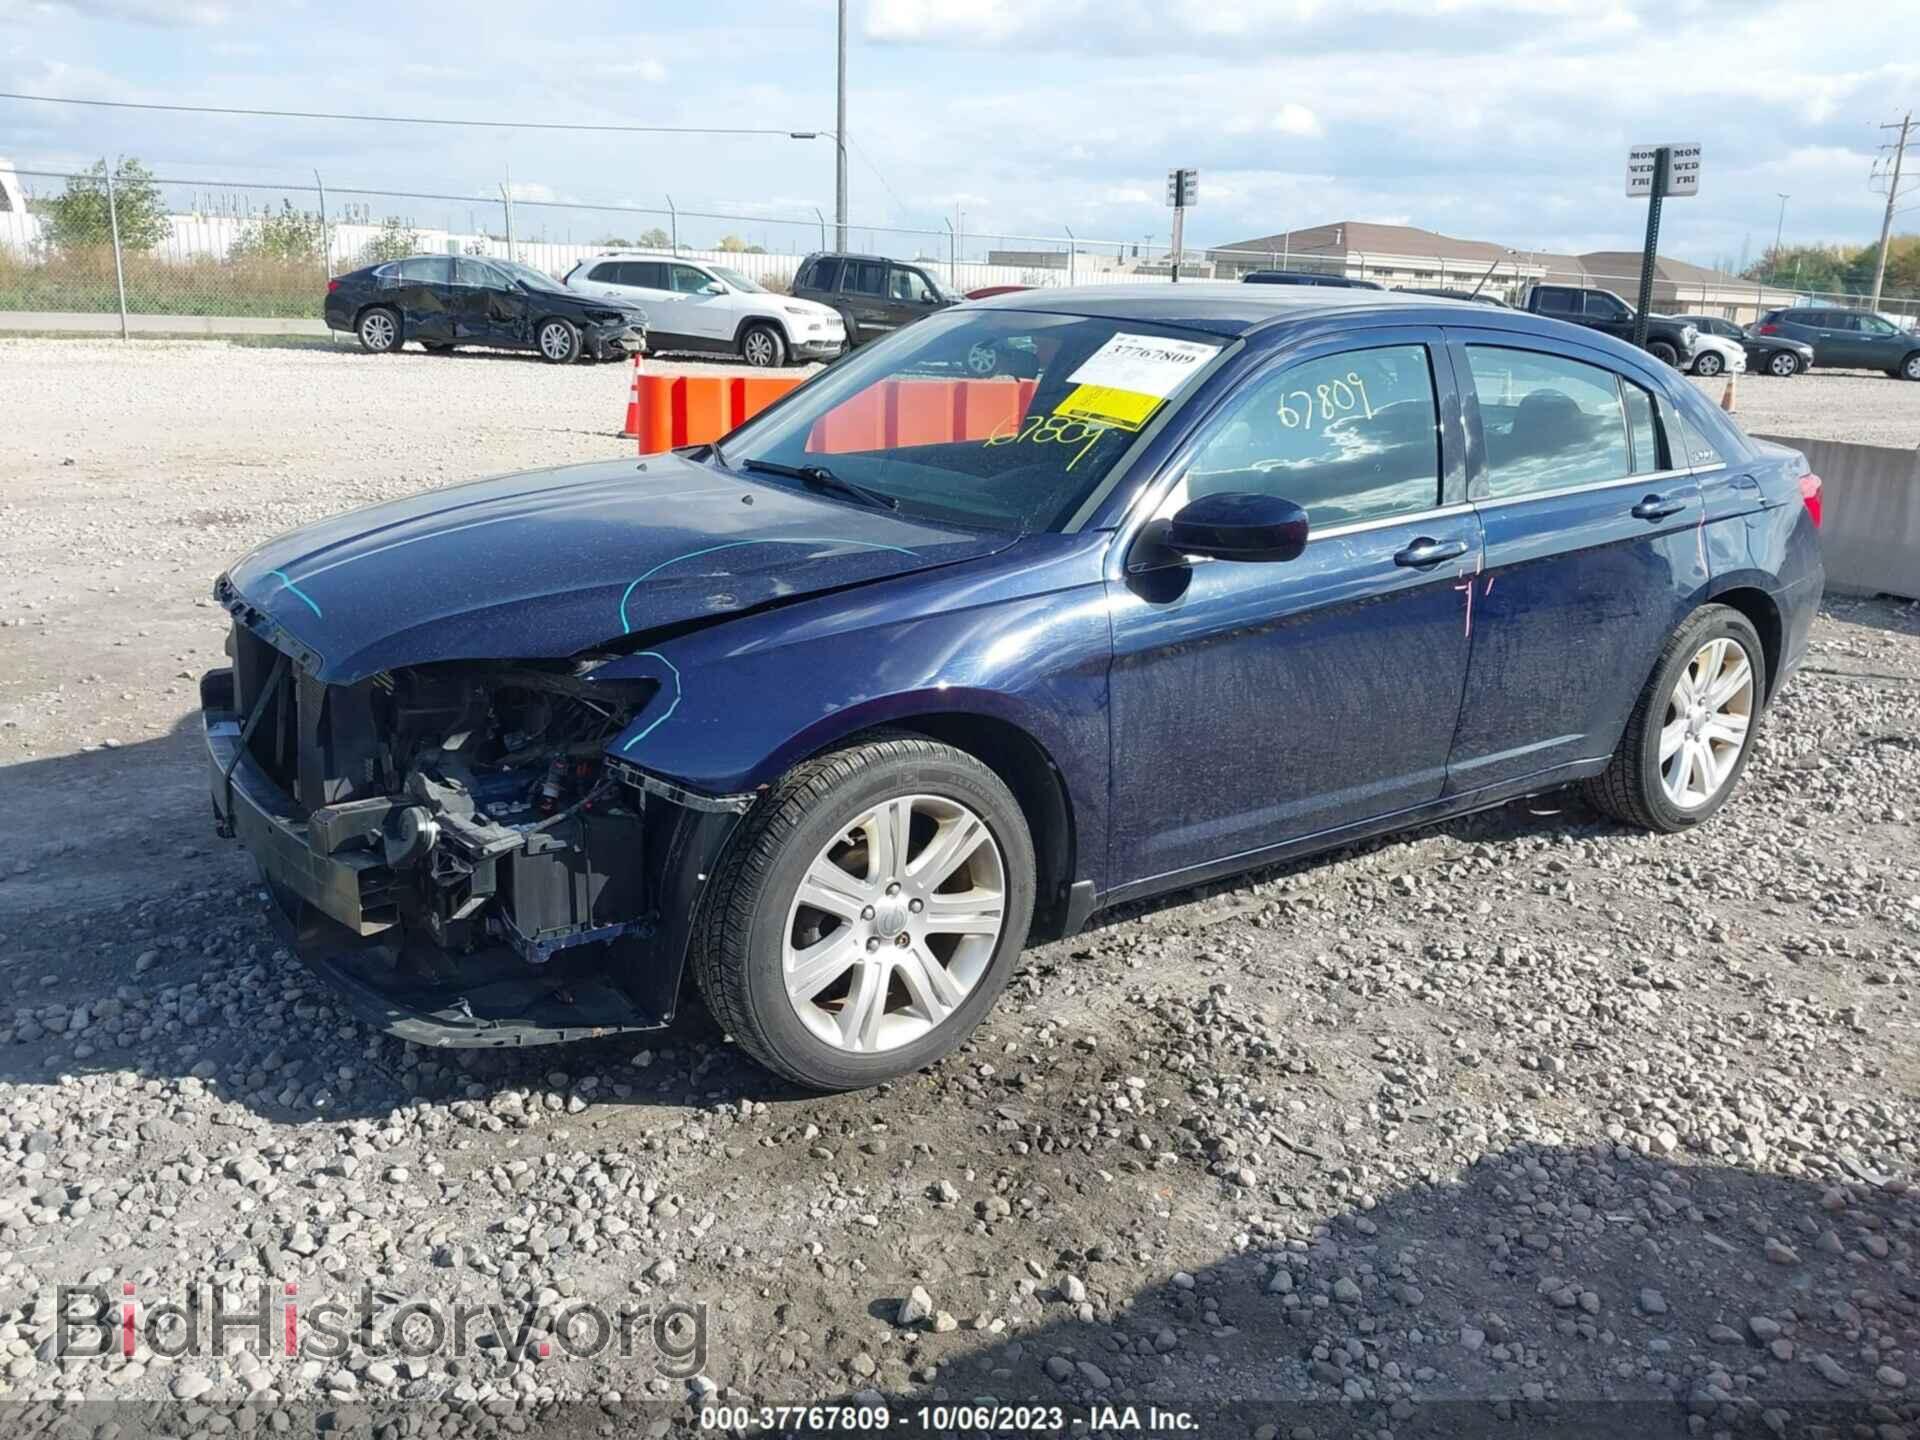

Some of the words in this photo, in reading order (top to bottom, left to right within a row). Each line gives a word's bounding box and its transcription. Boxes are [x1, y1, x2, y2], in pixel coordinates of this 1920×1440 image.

[1630, 151, 1655, 160] MON
[1673, 148, 1700, 157] MON
[1629, 164, 1654, 173] WED
[1673, 162, 1699, 171] WED
[1631, 177, 1650, 186] FRI
[1676, 175, 1695, 184] FRI
[1106, 345, 1197, 364] 37767809
[1277, 372, 1372, 429] 67809
[983, 416, 1104, 471] 67809
